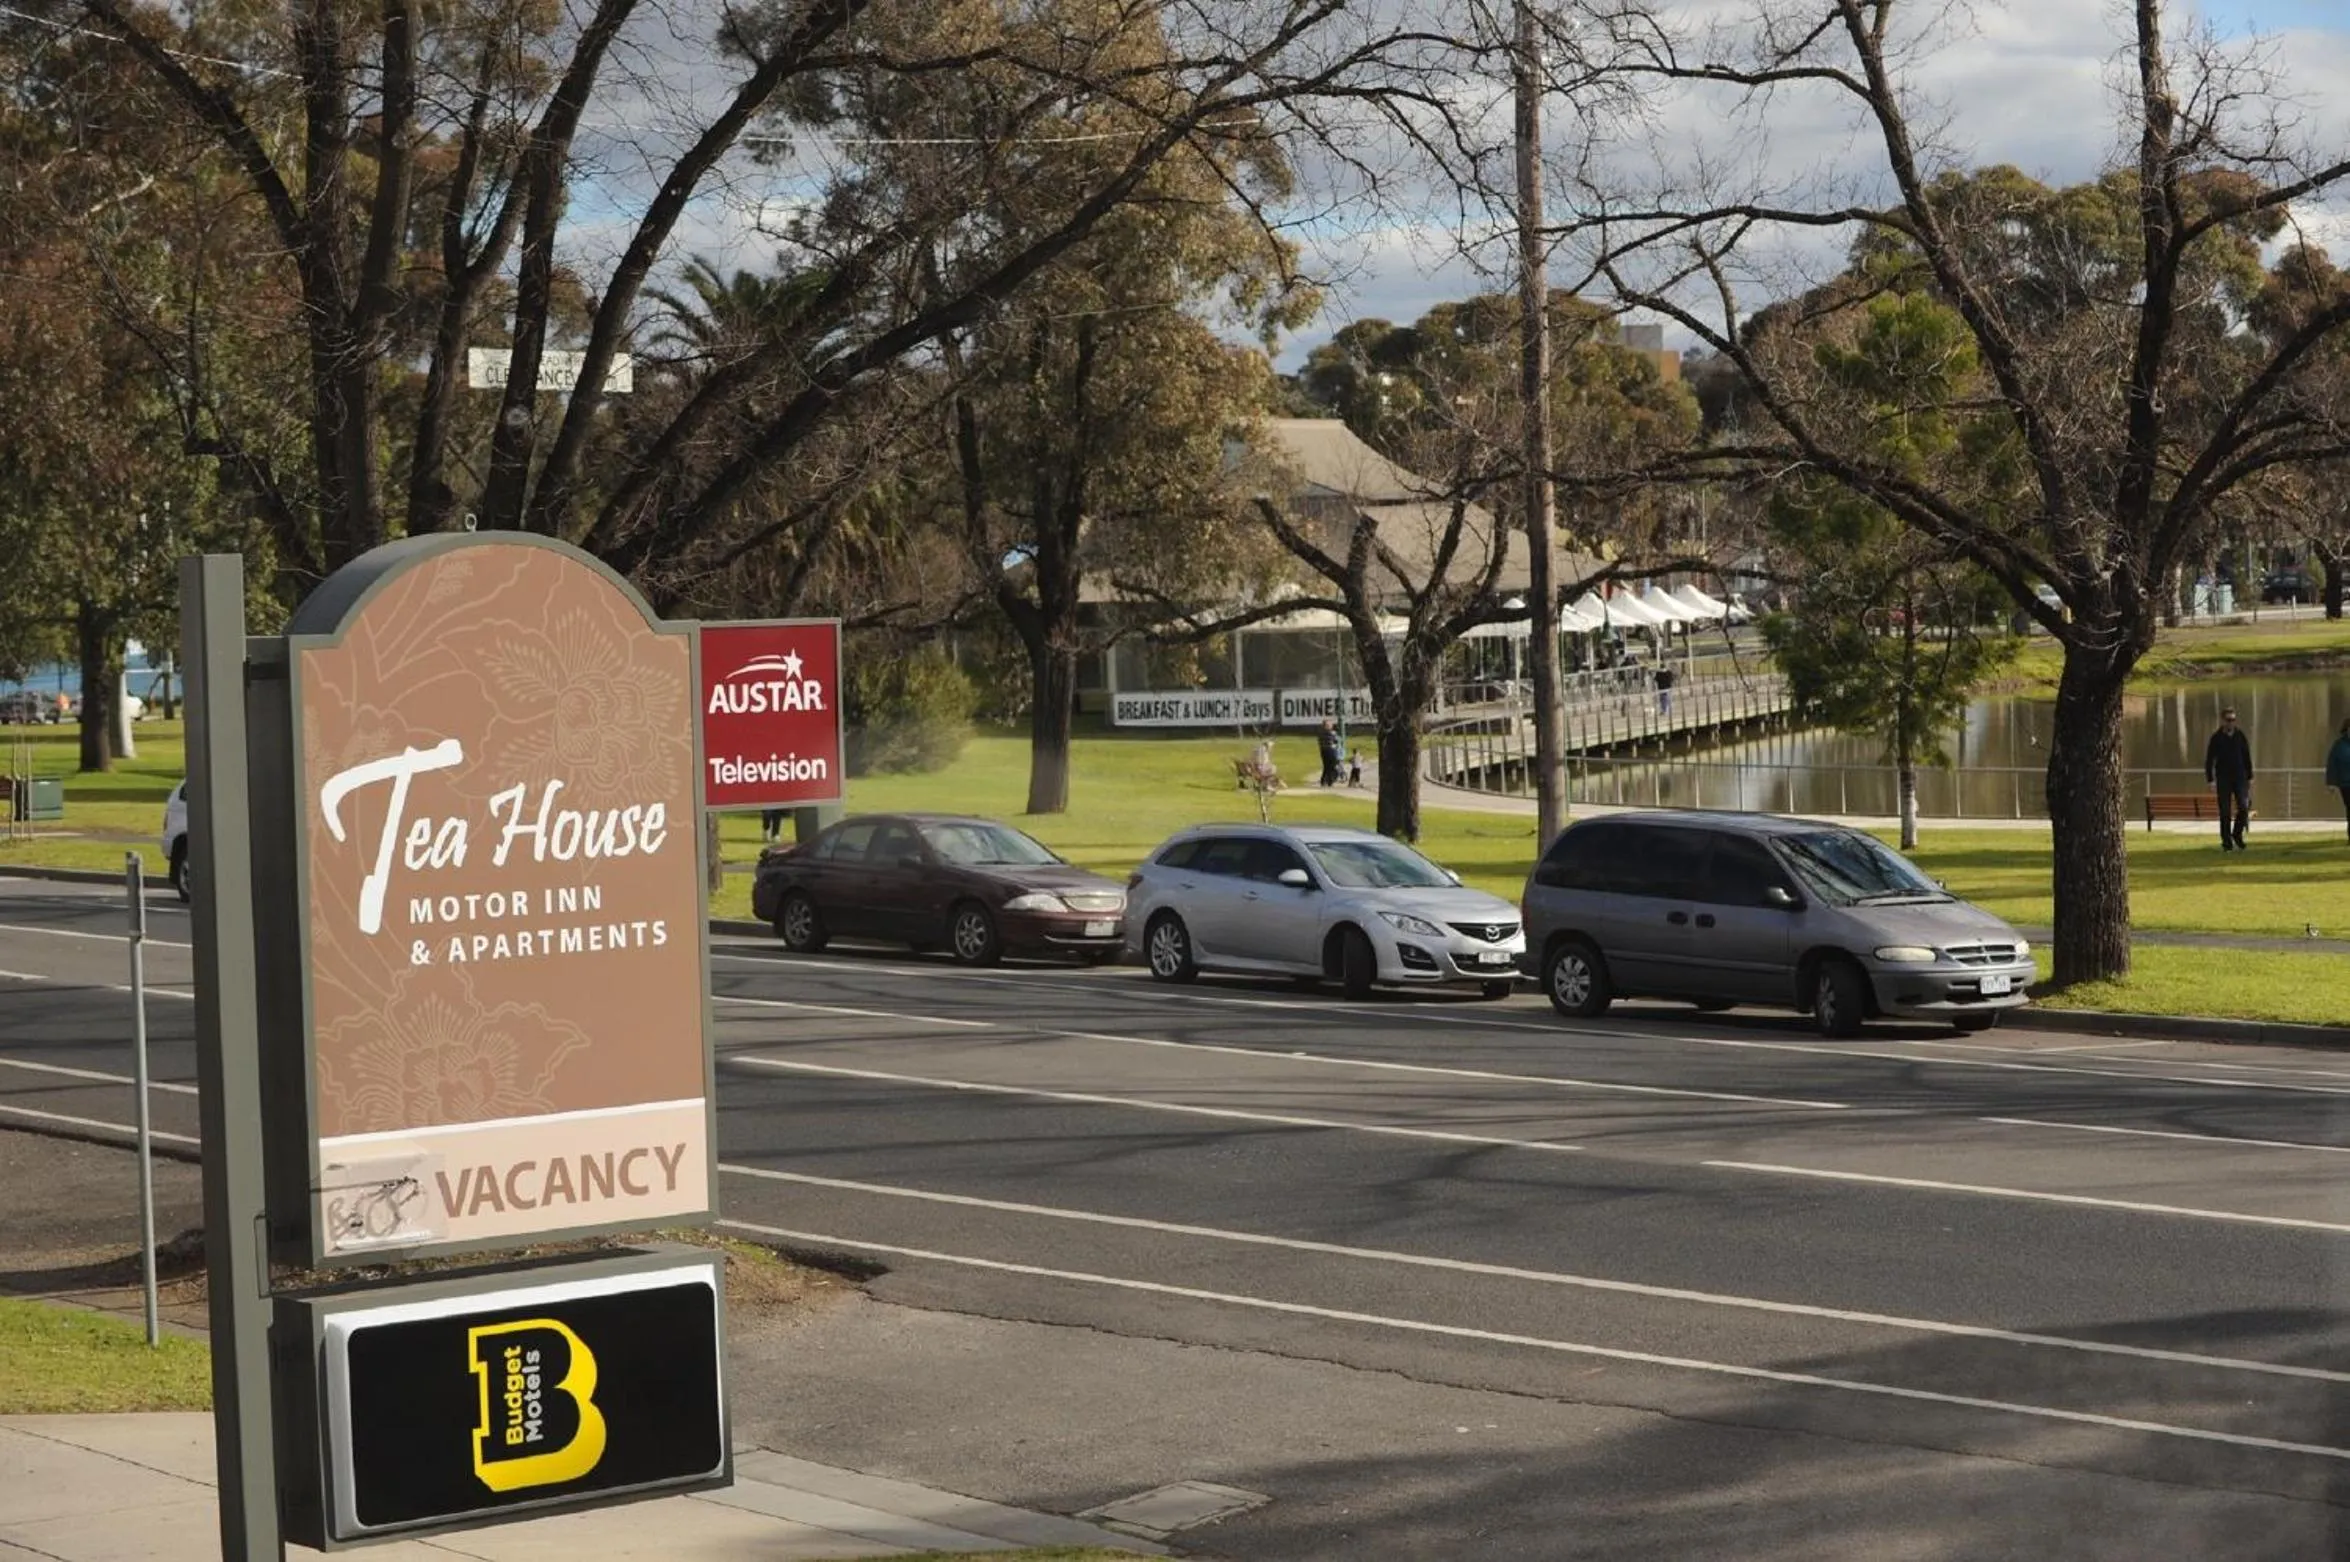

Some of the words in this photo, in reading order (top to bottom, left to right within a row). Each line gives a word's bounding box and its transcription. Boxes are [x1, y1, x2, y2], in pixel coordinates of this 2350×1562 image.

[709, 679, 823, 714] AUSTAR
[1118, 700, 1180, 720] BREAKFAST
[1183, 702, 1190, 718] &
[1194, 699, 1230, 719] LUNCH
[1243, 698, 1270, 720] Days
[709, 752, 827, 784] Television
[320, 738, 468, 935] Tea
[489, 778, 667, 866] House
[409, 890, 528, 924] MOTOR
[545, 885, 601, 913] INN
[410, 939, 430, 965] &
[448, 920, 667, 963] APARTMENTS
[434, 1142, 686, 1219] VACANCY
[504, 1345, 525, 1445] Budget
[521, 1349, 544, 1442] Motels
